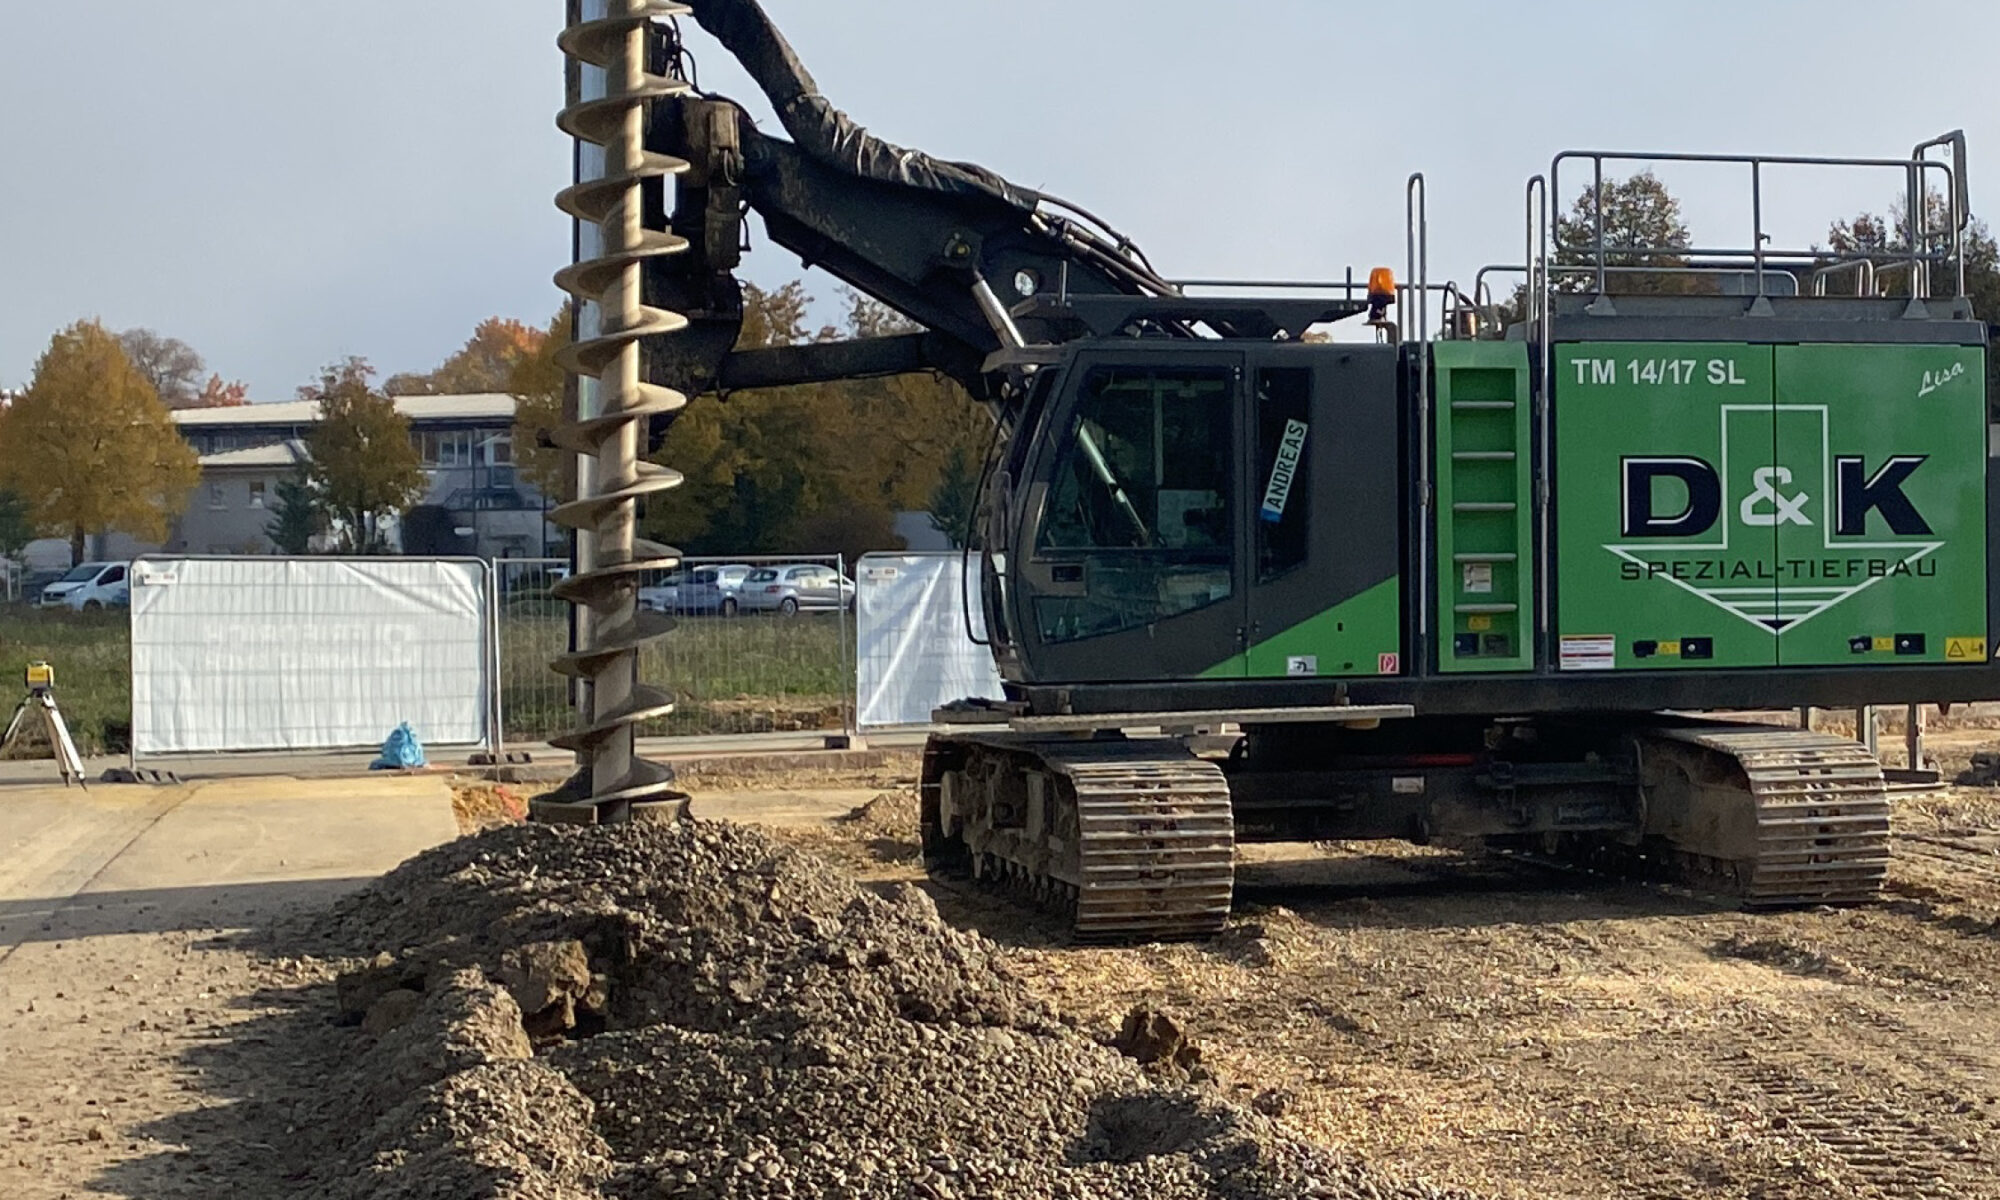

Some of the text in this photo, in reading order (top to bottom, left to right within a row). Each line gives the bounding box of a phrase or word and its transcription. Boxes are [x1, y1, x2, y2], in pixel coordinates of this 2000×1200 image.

[1571, 359, 1746, 385] TM 14/17 SL
[1918, 361, 1965, 398] Lisa
[1266, 423, 1305, 510] ANDREAS
[1620, 558, 1937, 581] SPEZIAL-TIEFBAU
